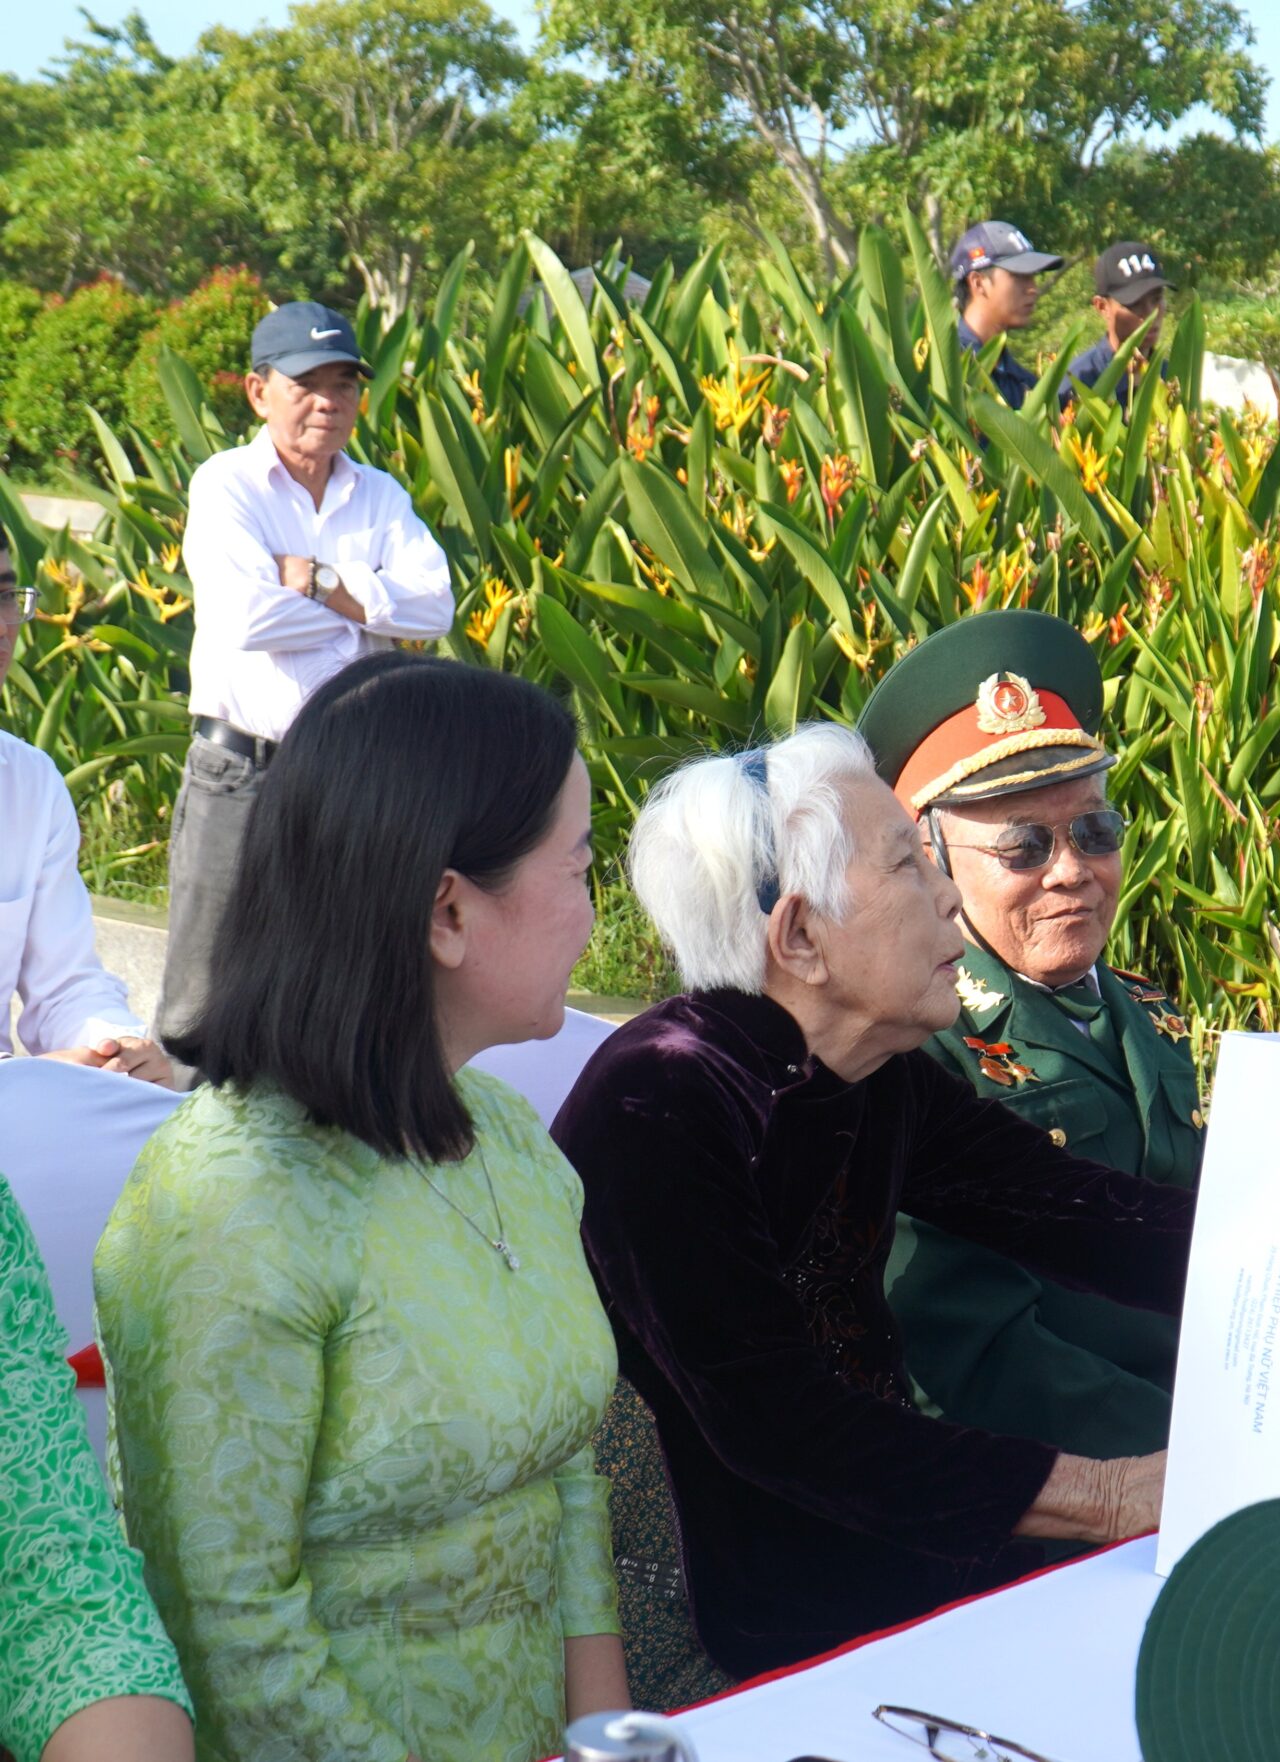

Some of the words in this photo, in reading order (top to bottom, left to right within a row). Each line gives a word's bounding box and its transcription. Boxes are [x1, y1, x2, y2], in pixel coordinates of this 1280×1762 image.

[1118, 253, 1156, 277] 114
[1256, 1371, 1270, 1401] VIỆT
[1252, 1401, 1265, 1433] NAM
